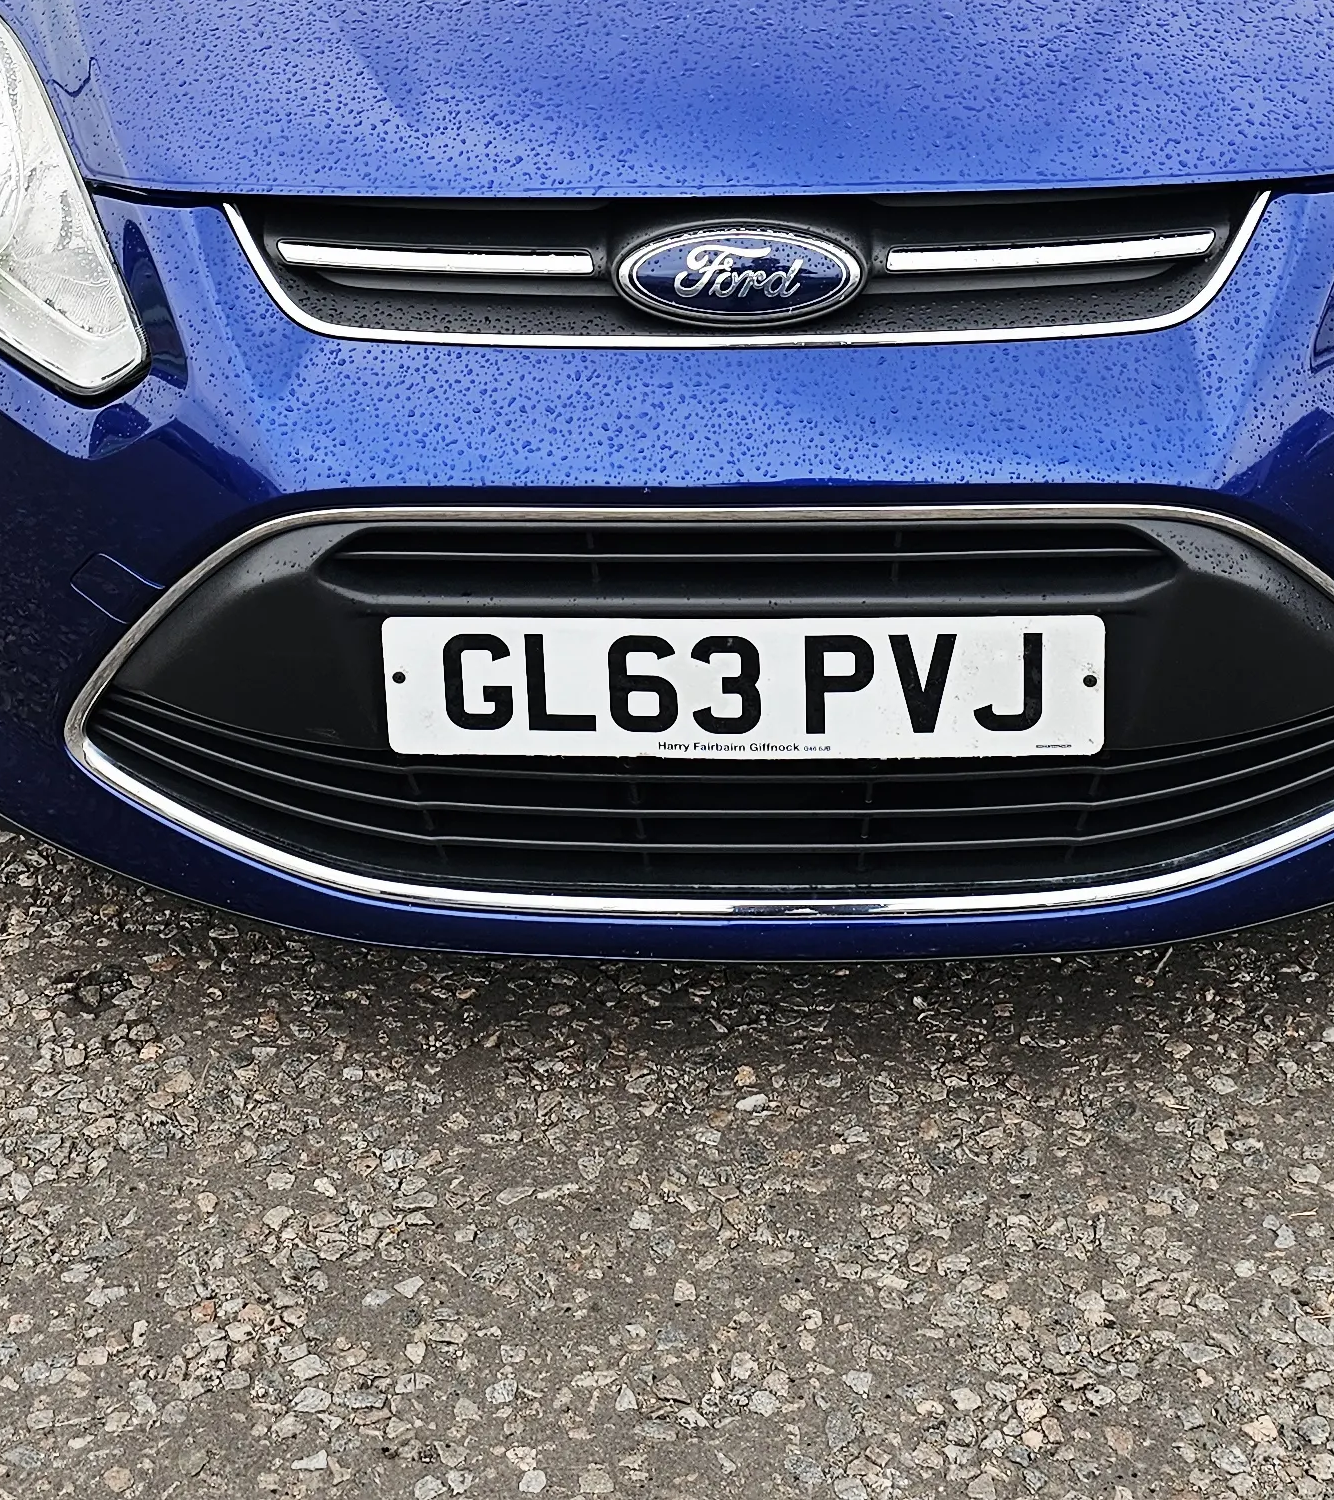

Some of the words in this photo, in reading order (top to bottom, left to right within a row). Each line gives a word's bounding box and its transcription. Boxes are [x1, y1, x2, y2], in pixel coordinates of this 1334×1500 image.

[674, 244, 804, 298] Ford
[442, 633, 762, 735] GL63
[804, 633, 1044, 734] PVJ
[658, 741, 690, 752] Harry
[693, 741, 746, 751] Fairbairn
[749, 742, 800, 751] Giffnock
